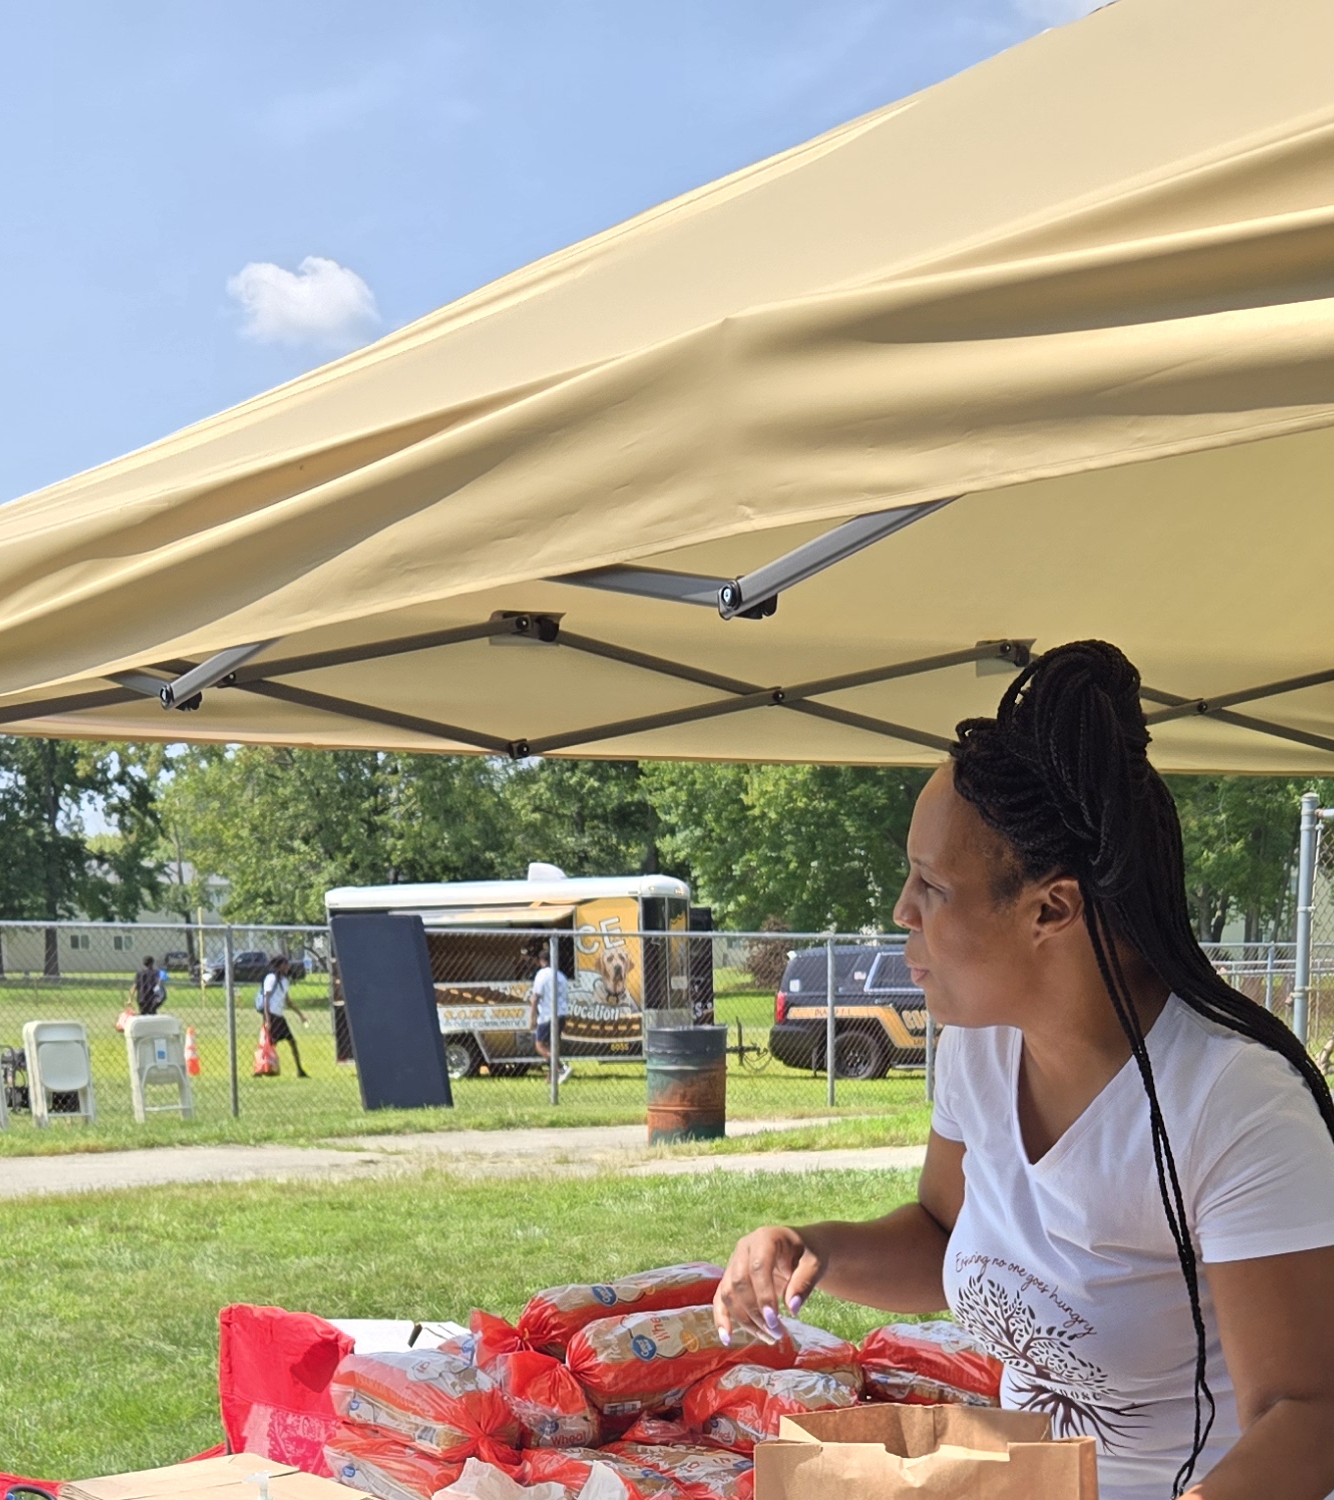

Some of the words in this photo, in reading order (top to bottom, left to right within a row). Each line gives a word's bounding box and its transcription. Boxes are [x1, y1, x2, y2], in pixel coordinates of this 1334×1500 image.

[992, 1256, 1007, 1268] no
[1007, 1262, 1028, 1277] one
[1020, 1270, 1050, 1293] goes
[1048, 1284, 1098, 1339] hungry
